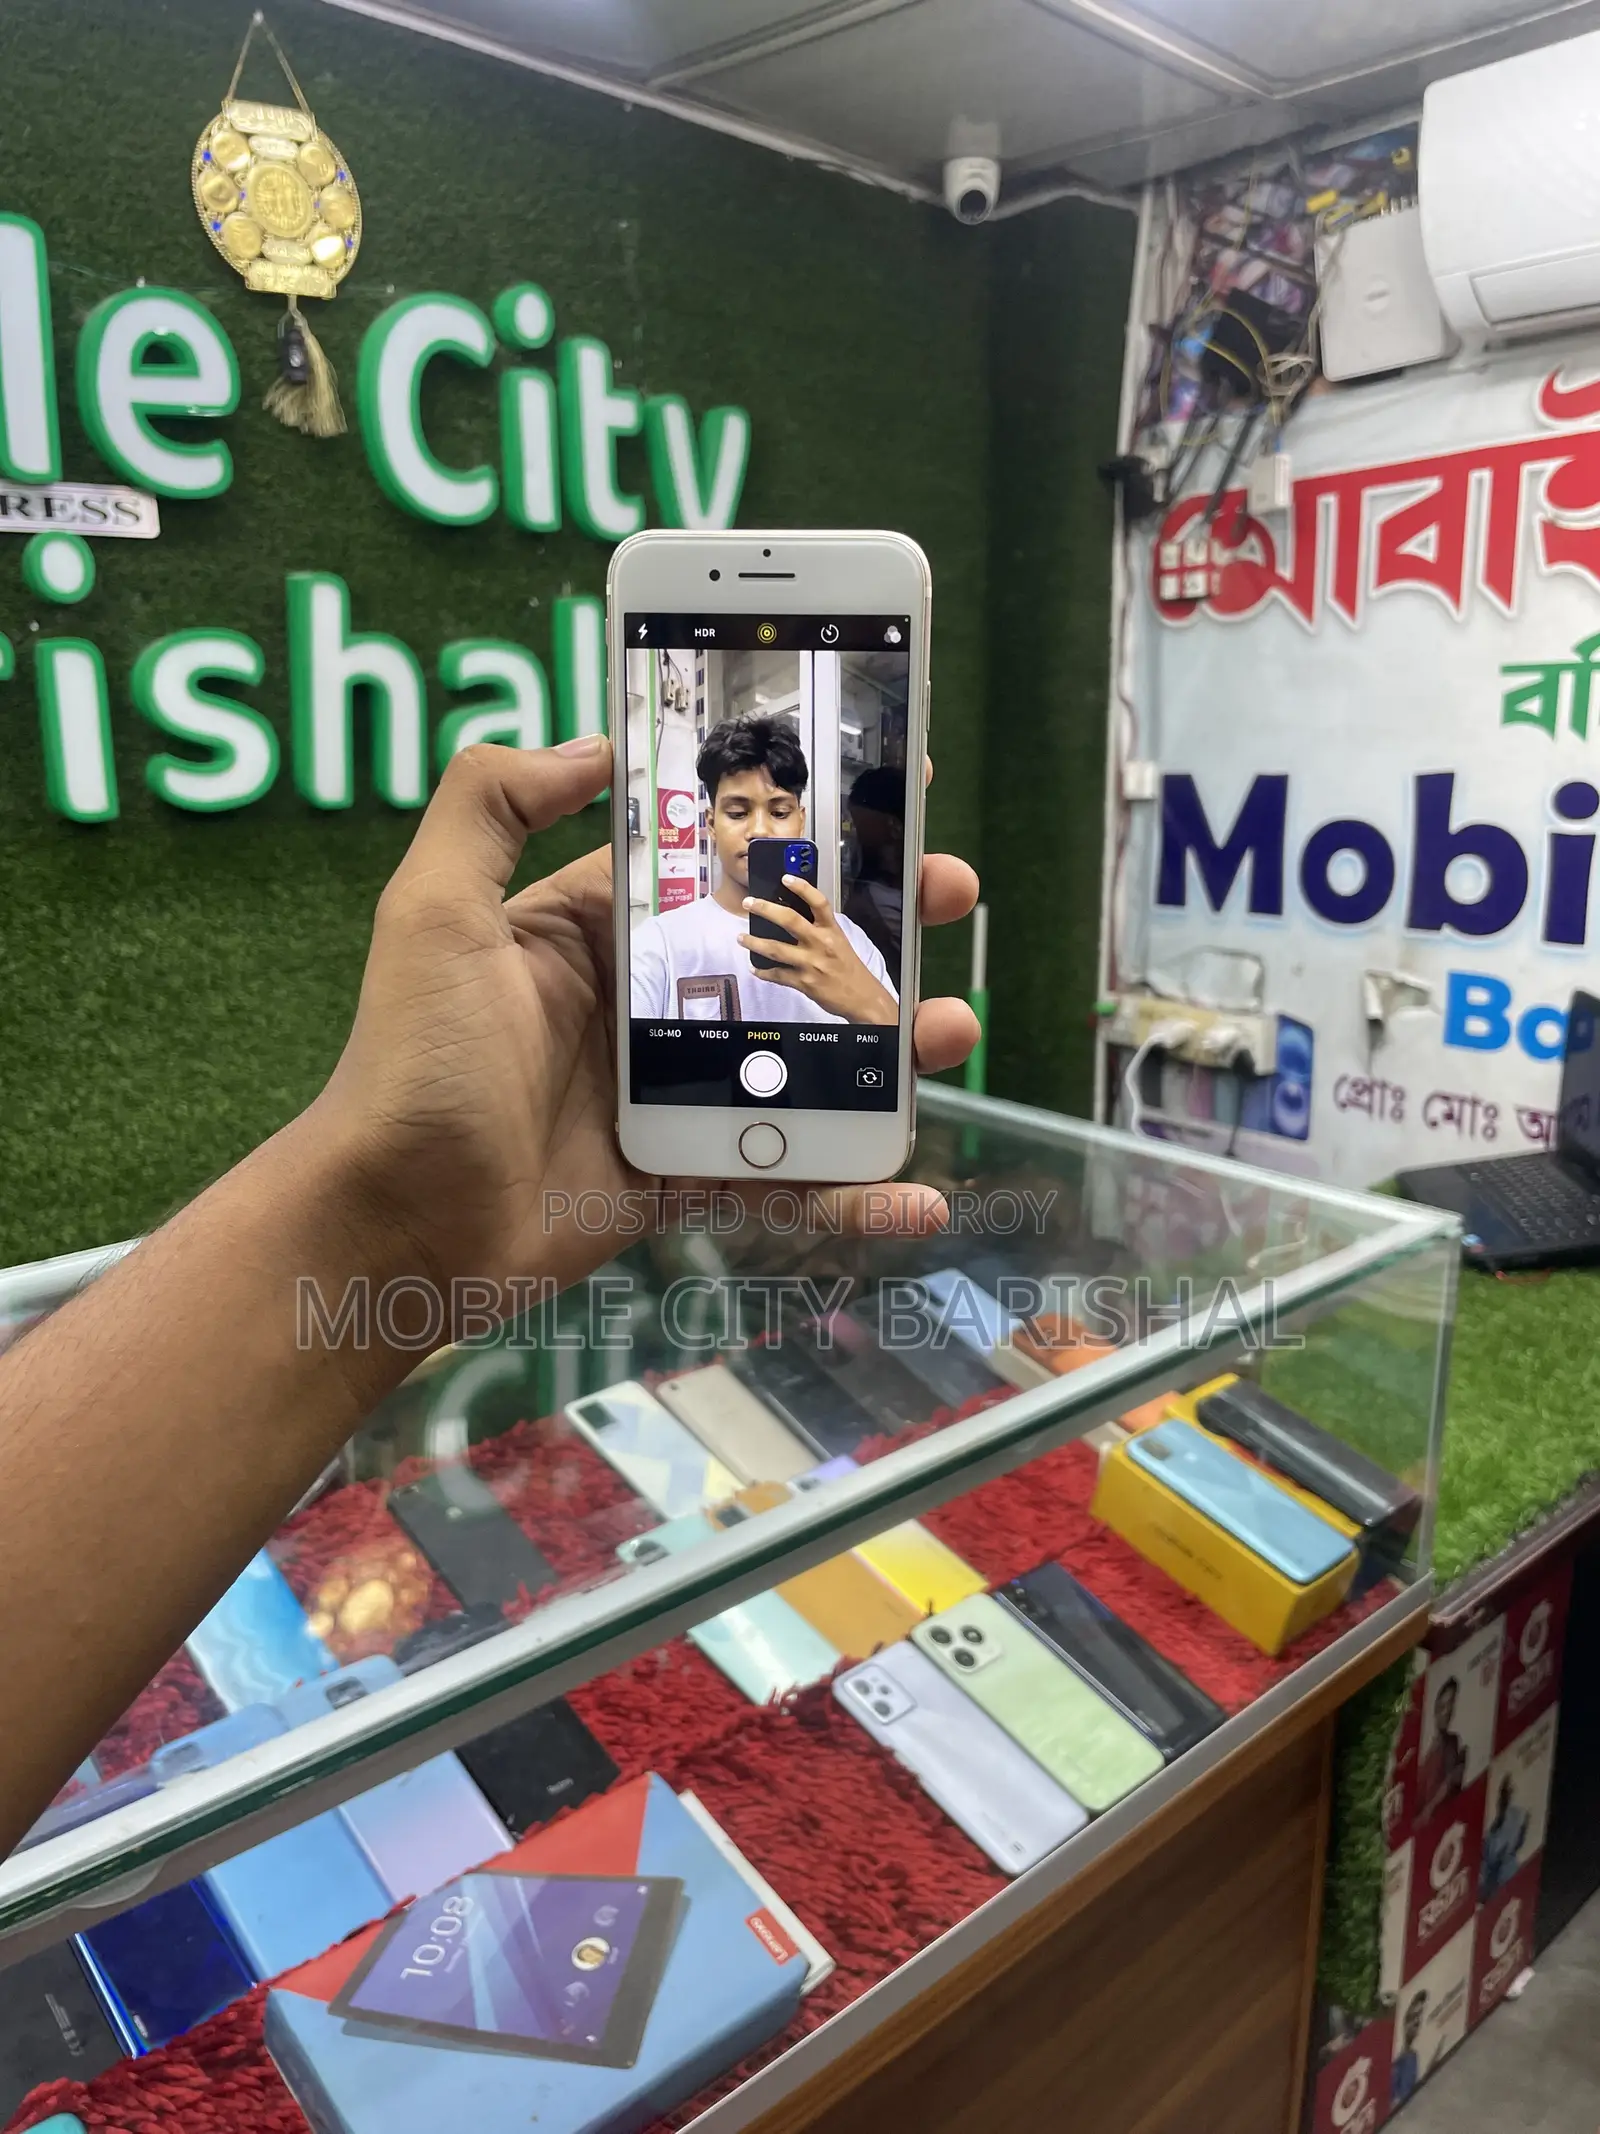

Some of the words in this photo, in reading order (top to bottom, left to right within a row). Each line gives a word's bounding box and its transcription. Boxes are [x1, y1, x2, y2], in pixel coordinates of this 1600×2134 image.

[357, 281, 752, 541] City
[694, 627, 716, 638] HDR
[0, 562, 609, 823] ishal
[1156, 771, 1600, 946] Mobi
[648, 1028, 682, 1038] SLO-MO
[699, 1029, 729, 1039] VIDEO
[747, 1031, 781, 1041] PHOTO
[798, 1032, 839, 1043] SQUARE
[856, 1034, 879, 1044] PANO
[1423, 1090, 1498, 1142] মোঃ
[400, 1896, 475, 1980] 10:08
